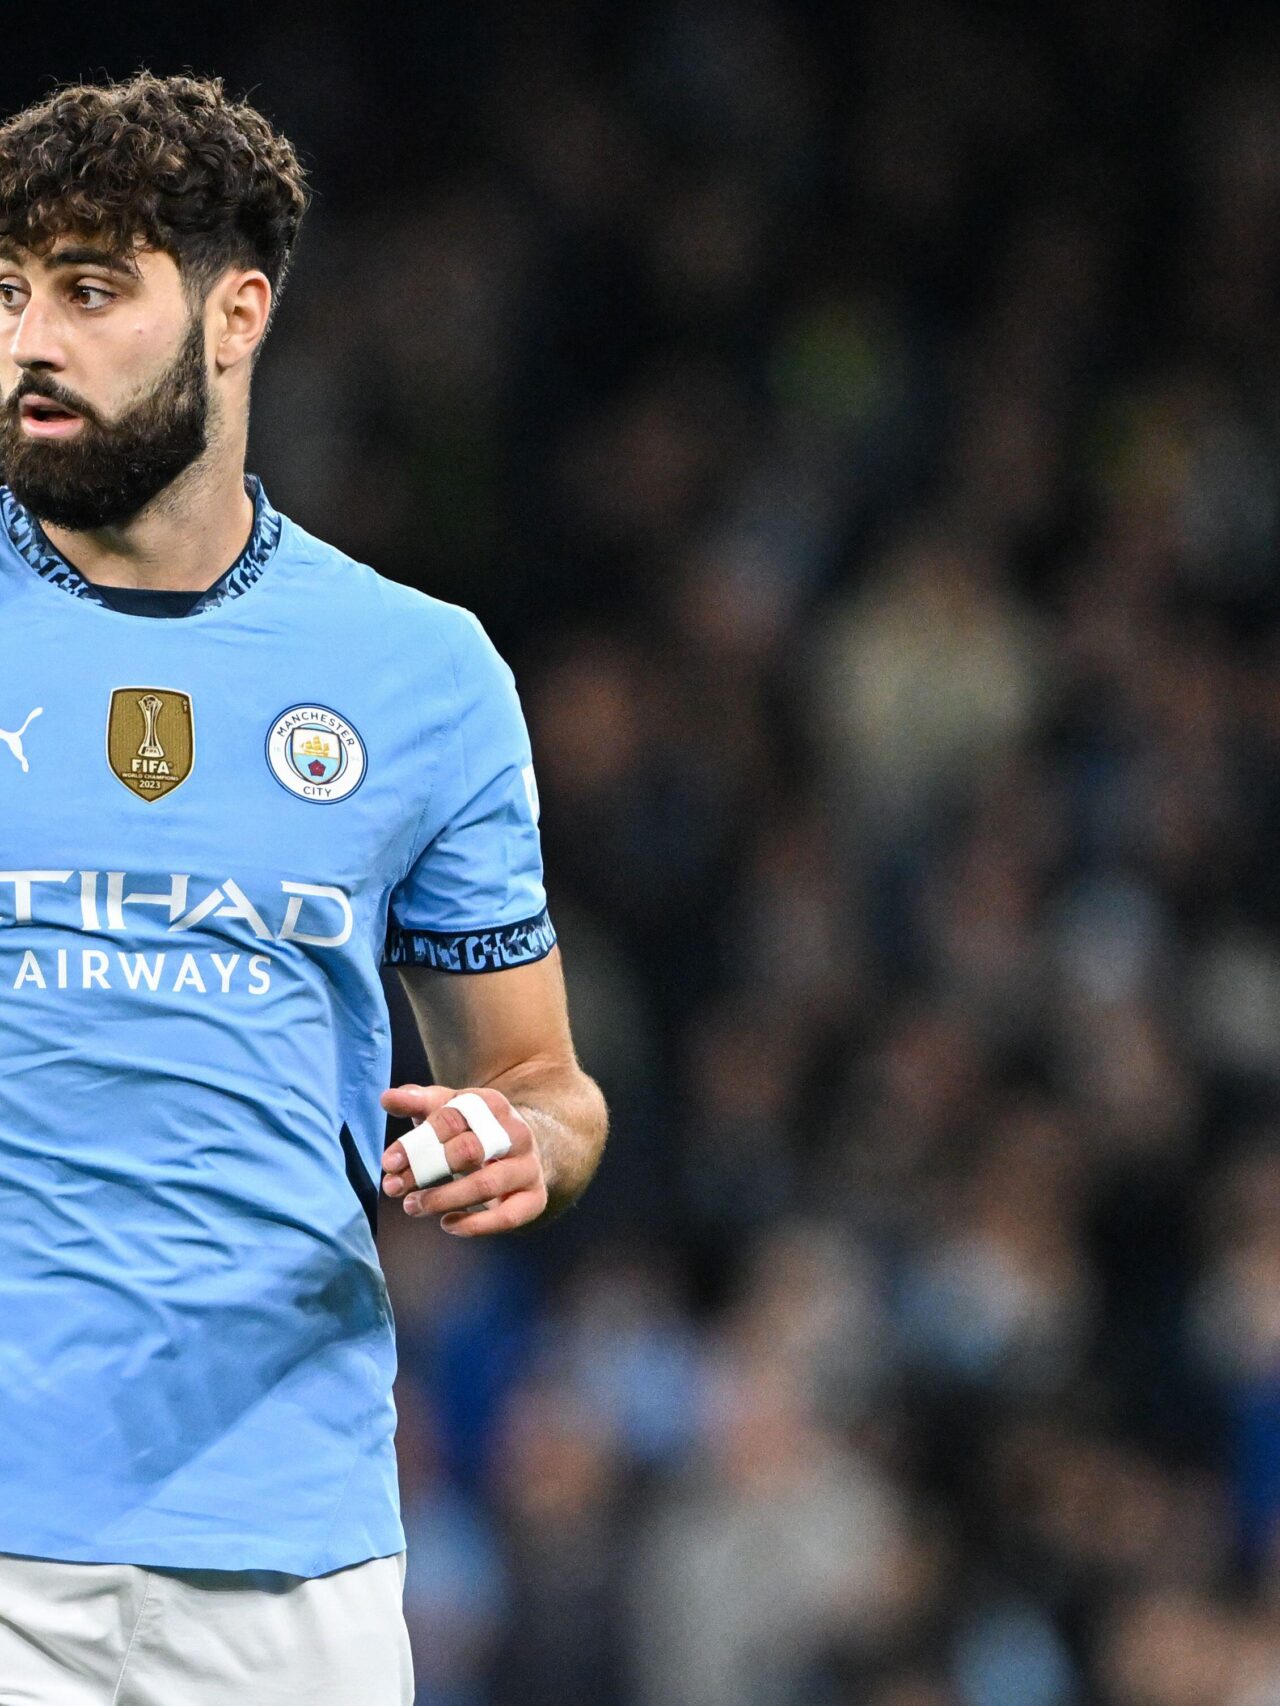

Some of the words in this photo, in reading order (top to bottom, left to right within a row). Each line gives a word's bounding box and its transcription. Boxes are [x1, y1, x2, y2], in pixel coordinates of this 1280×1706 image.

[276, 711, 355, 746] MANCHESTER
[132, 759, 169, 774] FIFA
[139, 781, 161, 789] 2023
[303, 786, 332, 797] CITY
[13, 949, 272, 995] AIRWAYS
